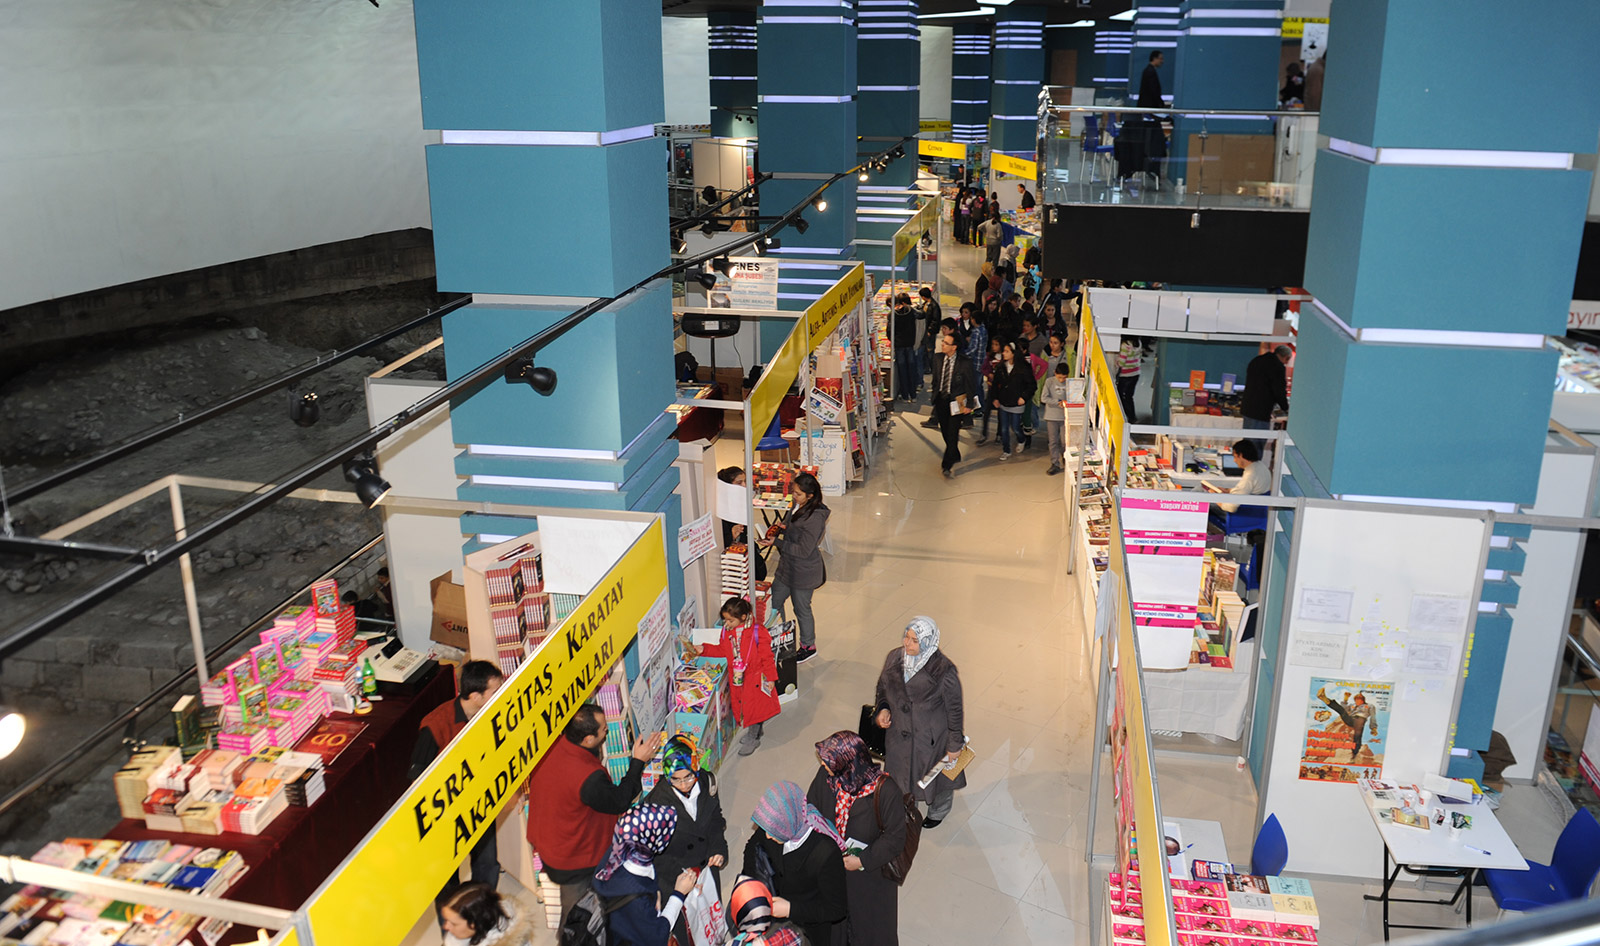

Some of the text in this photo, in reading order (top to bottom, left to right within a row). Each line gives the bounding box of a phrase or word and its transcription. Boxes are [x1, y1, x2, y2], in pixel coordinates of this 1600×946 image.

[453, 634, 614, 857] AKADEMİ YAYINLARI
[490, 663, 553, 752] EĞİTAŞ
[565, 576, 625, 662] KARATAY
